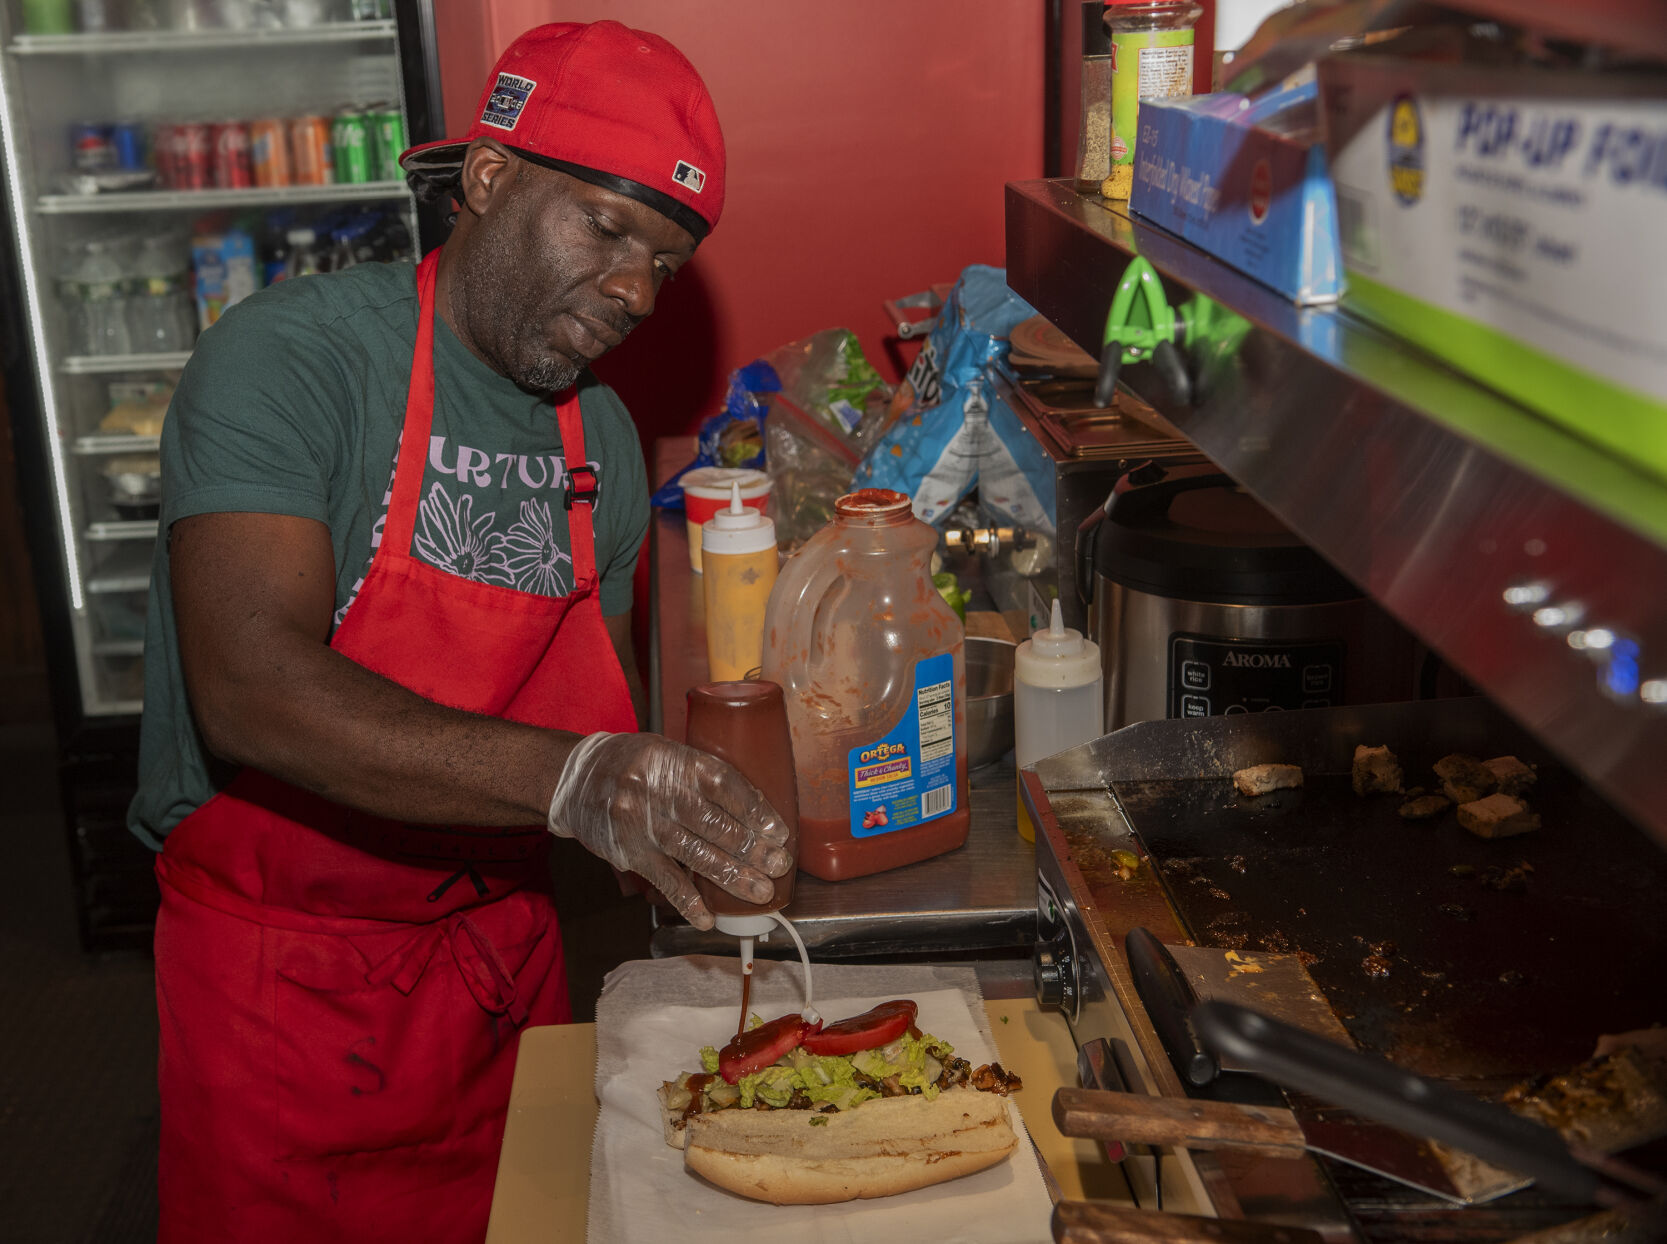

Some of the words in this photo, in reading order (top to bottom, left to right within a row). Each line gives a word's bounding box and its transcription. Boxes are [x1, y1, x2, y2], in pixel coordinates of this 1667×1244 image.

[498, 75, 533, 92] WORLD
[482, 113, 515, 128] SERIES
[1222, 650, 1292, 668] AROMA
[918, 686, 938, 695] Nutrition
[938, 682, 950, 691] Facts
[919, 708, 939, 718] Calories
[943, 701, 951, 710] 10
[1187, 703, 1204, 712] keep
[860, 743, 906, 763] ORTEGA
[860, 768, 877, 778] Thick
